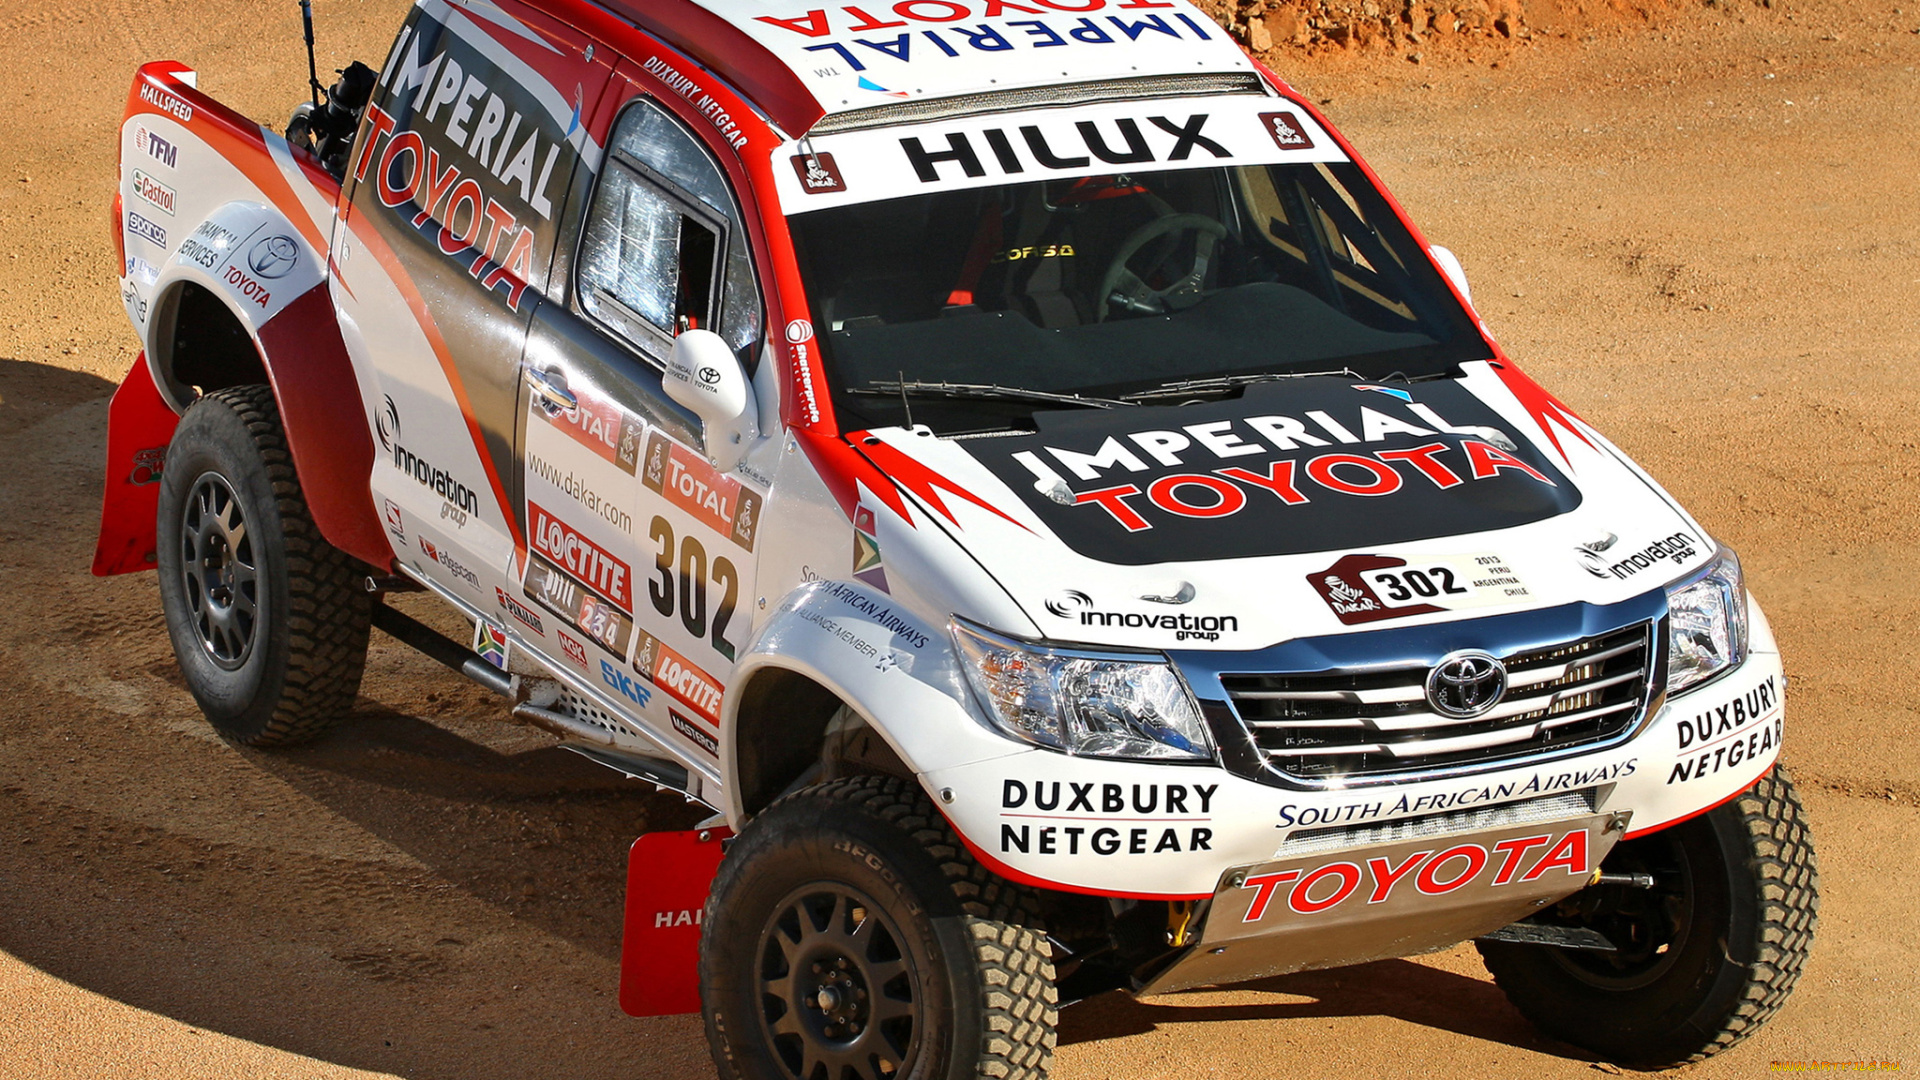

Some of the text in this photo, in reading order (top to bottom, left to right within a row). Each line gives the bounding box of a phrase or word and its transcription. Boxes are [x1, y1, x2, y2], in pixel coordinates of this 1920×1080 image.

[801, 13, 1213, 71] IMPERIAL
[140, 83, 193, 122] HALLSPEED
[380, 25, 560, 220] IMPERIAL
[643, 56, 749, 150] DUXBURY NETGEAR
[149, 132, 178, 168] TFM
[898, 114, 1234, 183] HILUX
[142, 177, 174, 212] Castrol
[353, 101, 534, 313] TOYOTA
[129, 213, 167, 244] sparco
[178, 239, 218, 268] SERVICES
[223, 265, 271, 309] TOYOTA
[694, 380, 718, 394] TOYOTA
[796, 344, 820, 423] Shatterprufe
[565, 404, 616, 449] OTAL
[1010, 402, 1478, 482] IMPERIAL
[394, 443, 479, 518] innovation
[528, 451, 632, 535] www.dakar.com
[669, 457, 732, 524] TOTAL
[1072, 439, 1558, 533] TOYOTA
[440, 501, 467, 529] group
[438, 551, 480, 588] edgecam
[535, 512, 626, 600] LOCTITE
[1474, 556, 1502, 565] 2013
[1488, 566, 1511, 575] PERU
[1608, 532, 1696, 580] innovation
[1671, 547, 1697, 565] group
[648, 514, 739, 664] 302
[1374, 567, 1468, 601] 302
[1473, 576, 1520, 587] ARGENTINA
[1504, 587, 1529, 597] CHILE
[800, 565, 836, 593] SOTH
[829, 583, 880, 616] AFRICAN
[873, 607, 930, 649] AIRWAYS
[1080, 611, 1238, 632] innovation
[1331, 597, 1379, 615] DAKAR
[560, 634, 586, 662] NGK
[834, 627, 878, 659] MEMBER
[1176, 630, 1220, 642] group
[600, 659, 652, 709] SKF
[657, 656, 723, 715] LOCTITE
[1676, 675, 1778, 749] DUXBURY
[1666, 718, 1782, 785] NETGEAR
[1002, 779, 1219, 814] DUXBURY
[1275, 758, 1639, 828] SOUTH AFRICAN AIRWAYS
[1001, 824, 1213, 856] NETGEAR
[1240, 828, 1590, 924] TOYOTA
